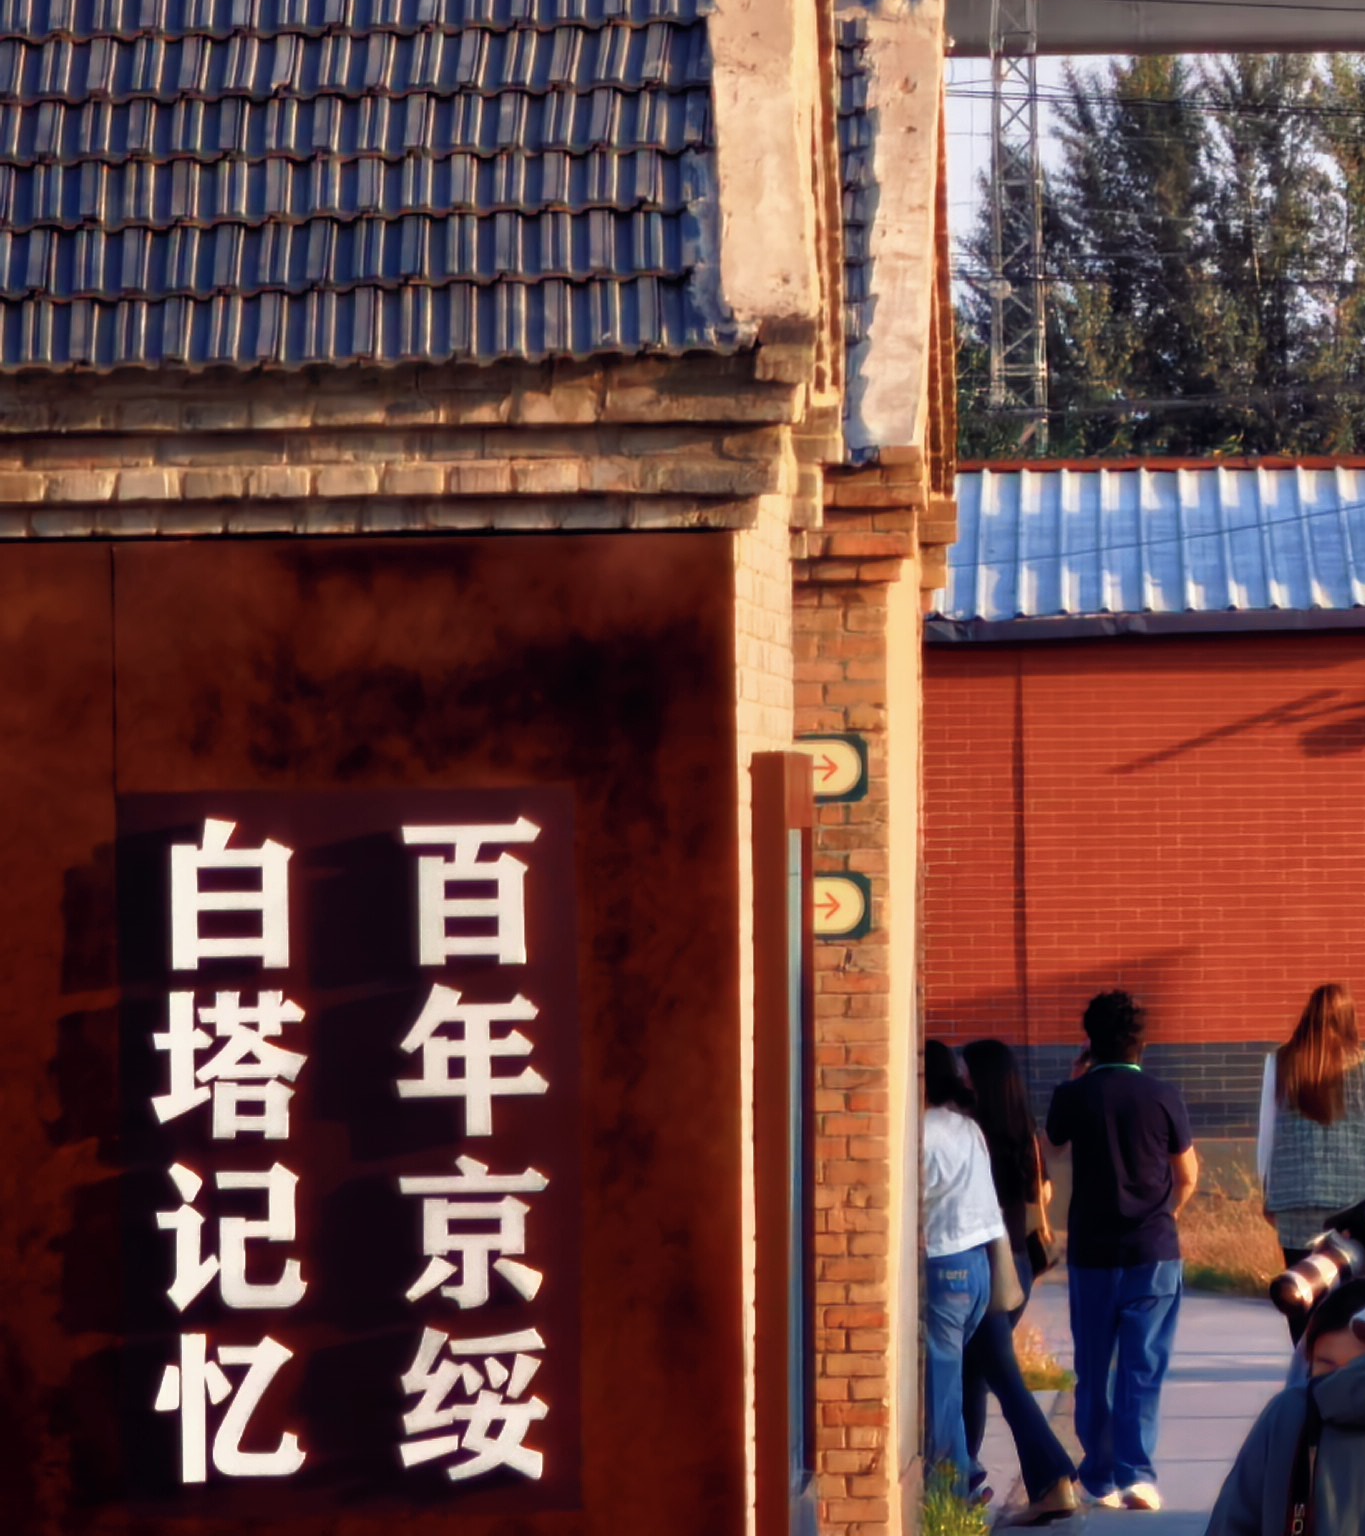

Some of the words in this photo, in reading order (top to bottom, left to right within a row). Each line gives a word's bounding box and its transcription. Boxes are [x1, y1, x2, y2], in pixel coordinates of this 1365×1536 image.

[150, 817, 308, 1484] 白塔记忆
[396, 817, 550, 1483] 百年京绥
[1292, 1503, 1305, 1536] SO
